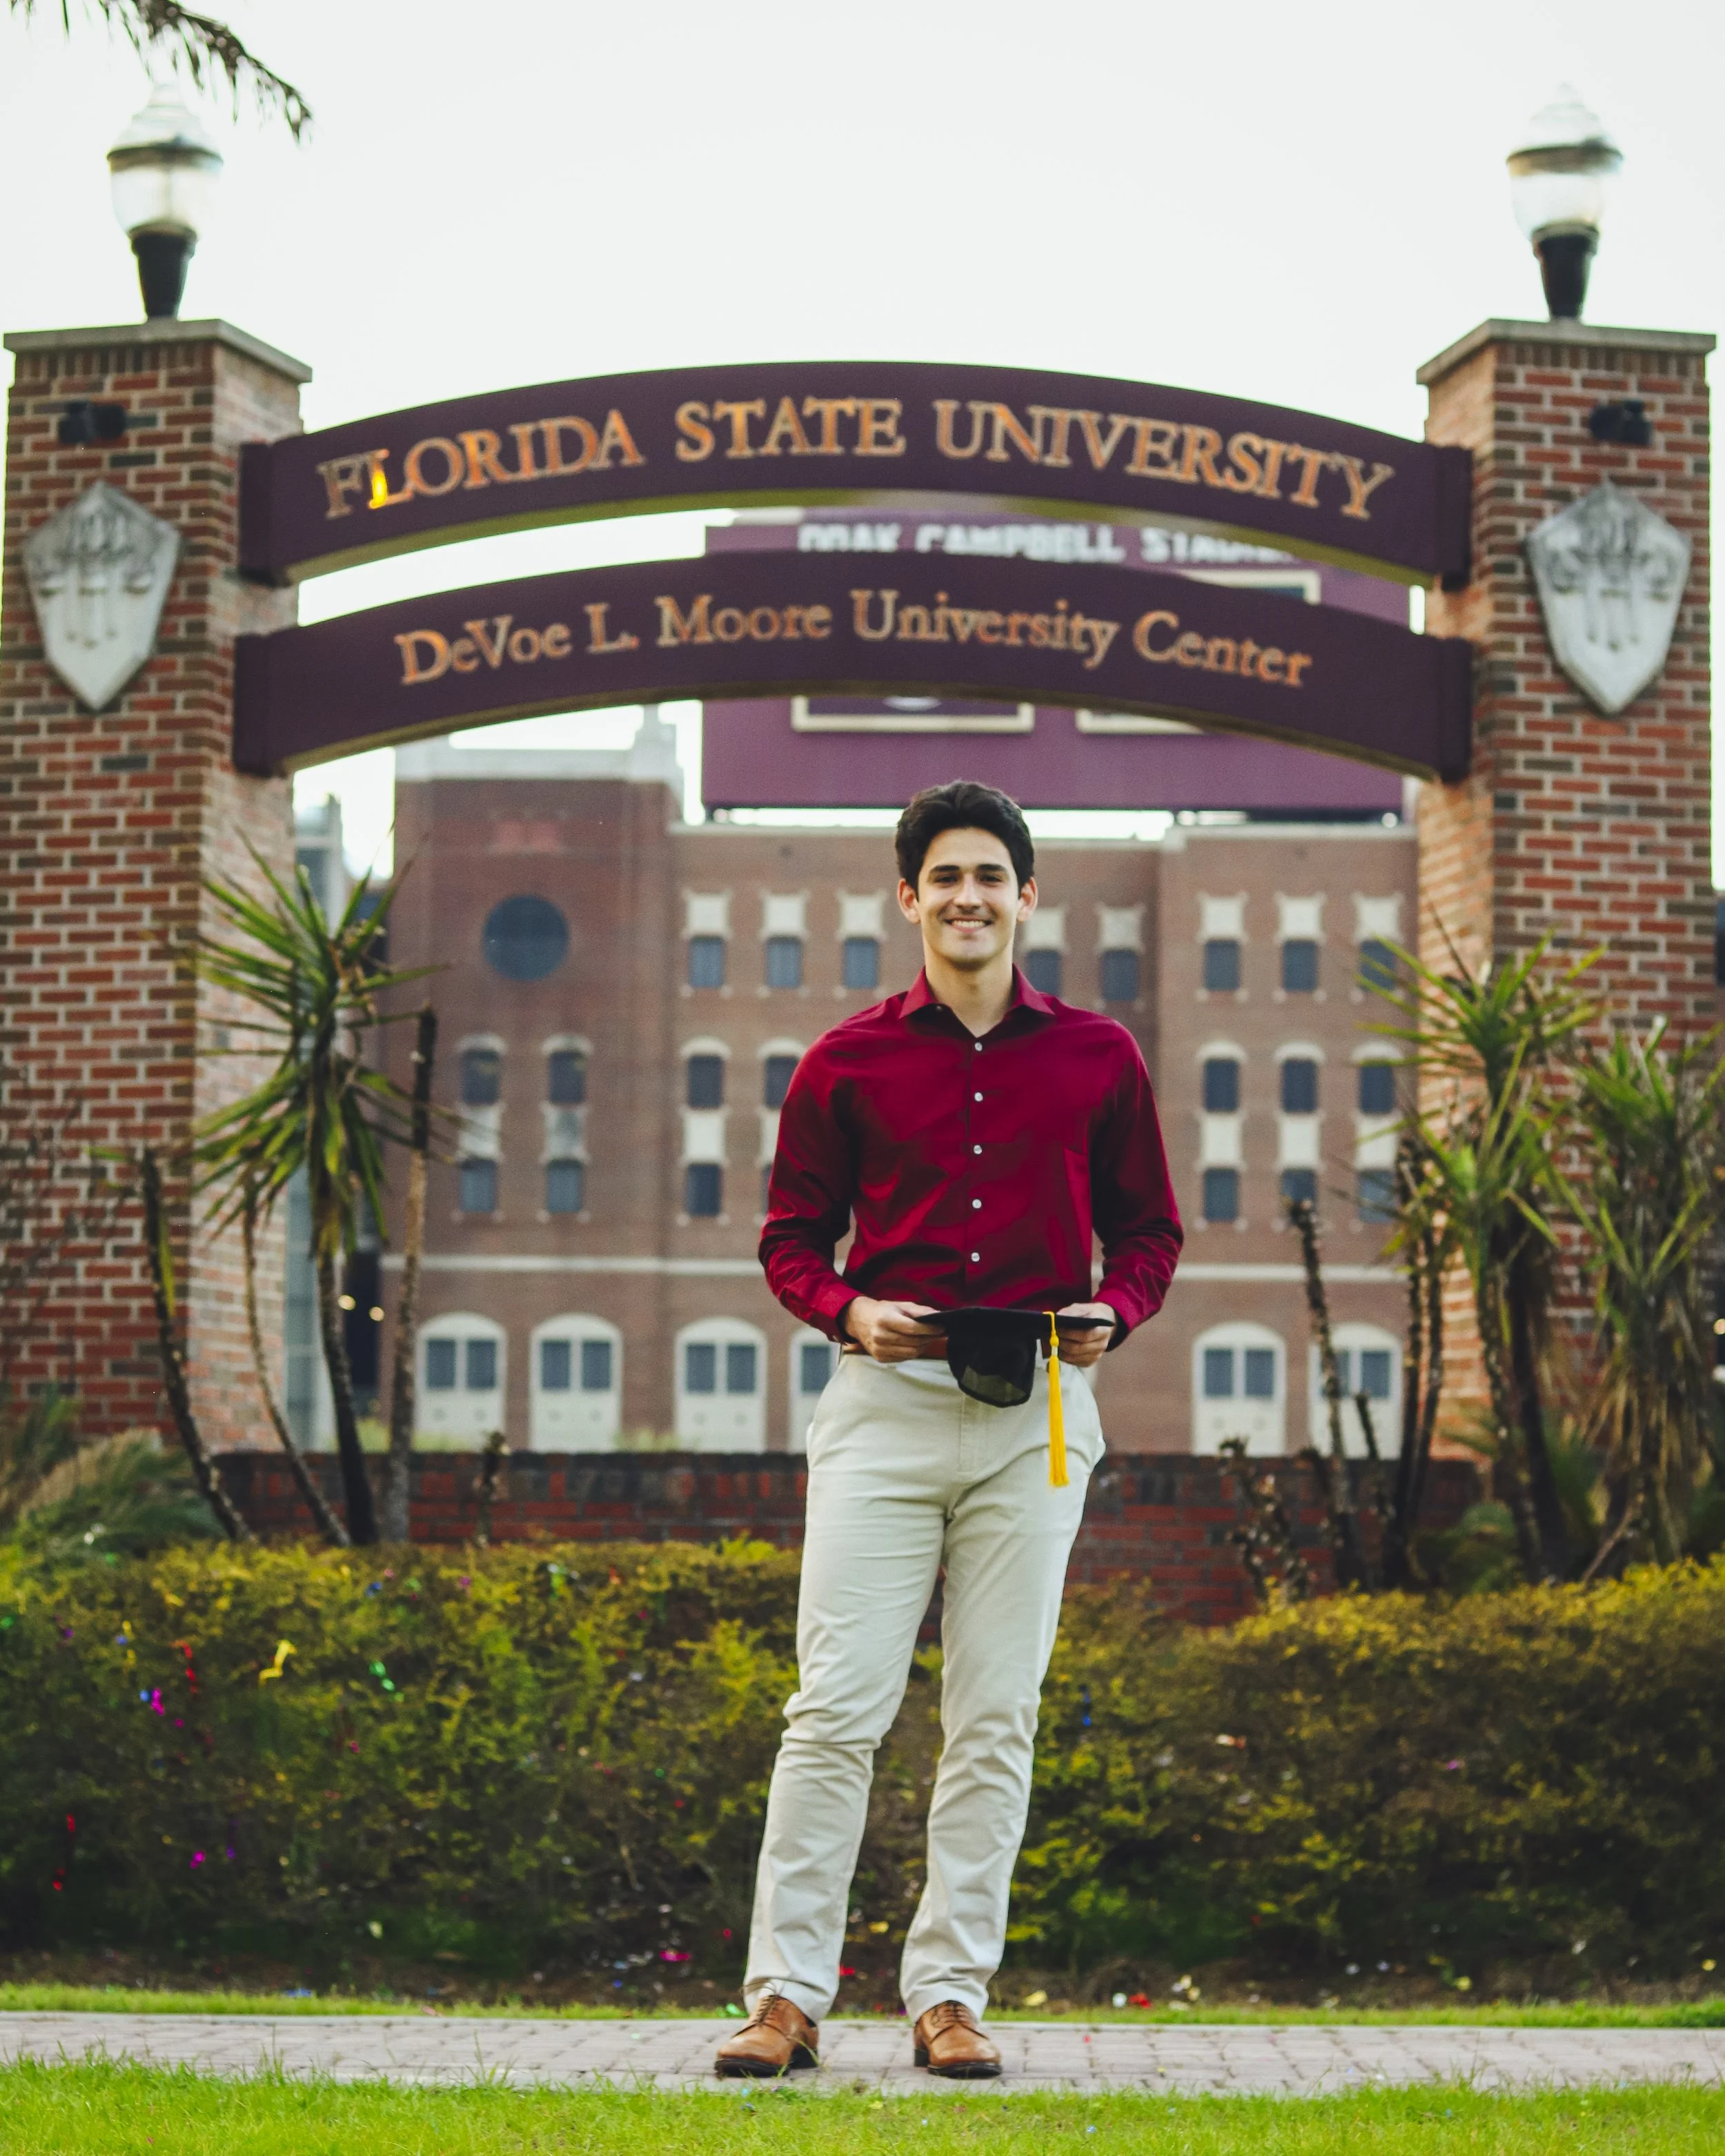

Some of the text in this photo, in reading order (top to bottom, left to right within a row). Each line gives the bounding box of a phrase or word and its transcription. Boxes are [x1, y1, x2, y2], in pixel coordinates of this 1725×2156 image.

[317, 397, 1394, 520] FLORIDA STATE UNIVERSITY
[394, 589, 1312, 688] DeVoe L. Moore University Center
